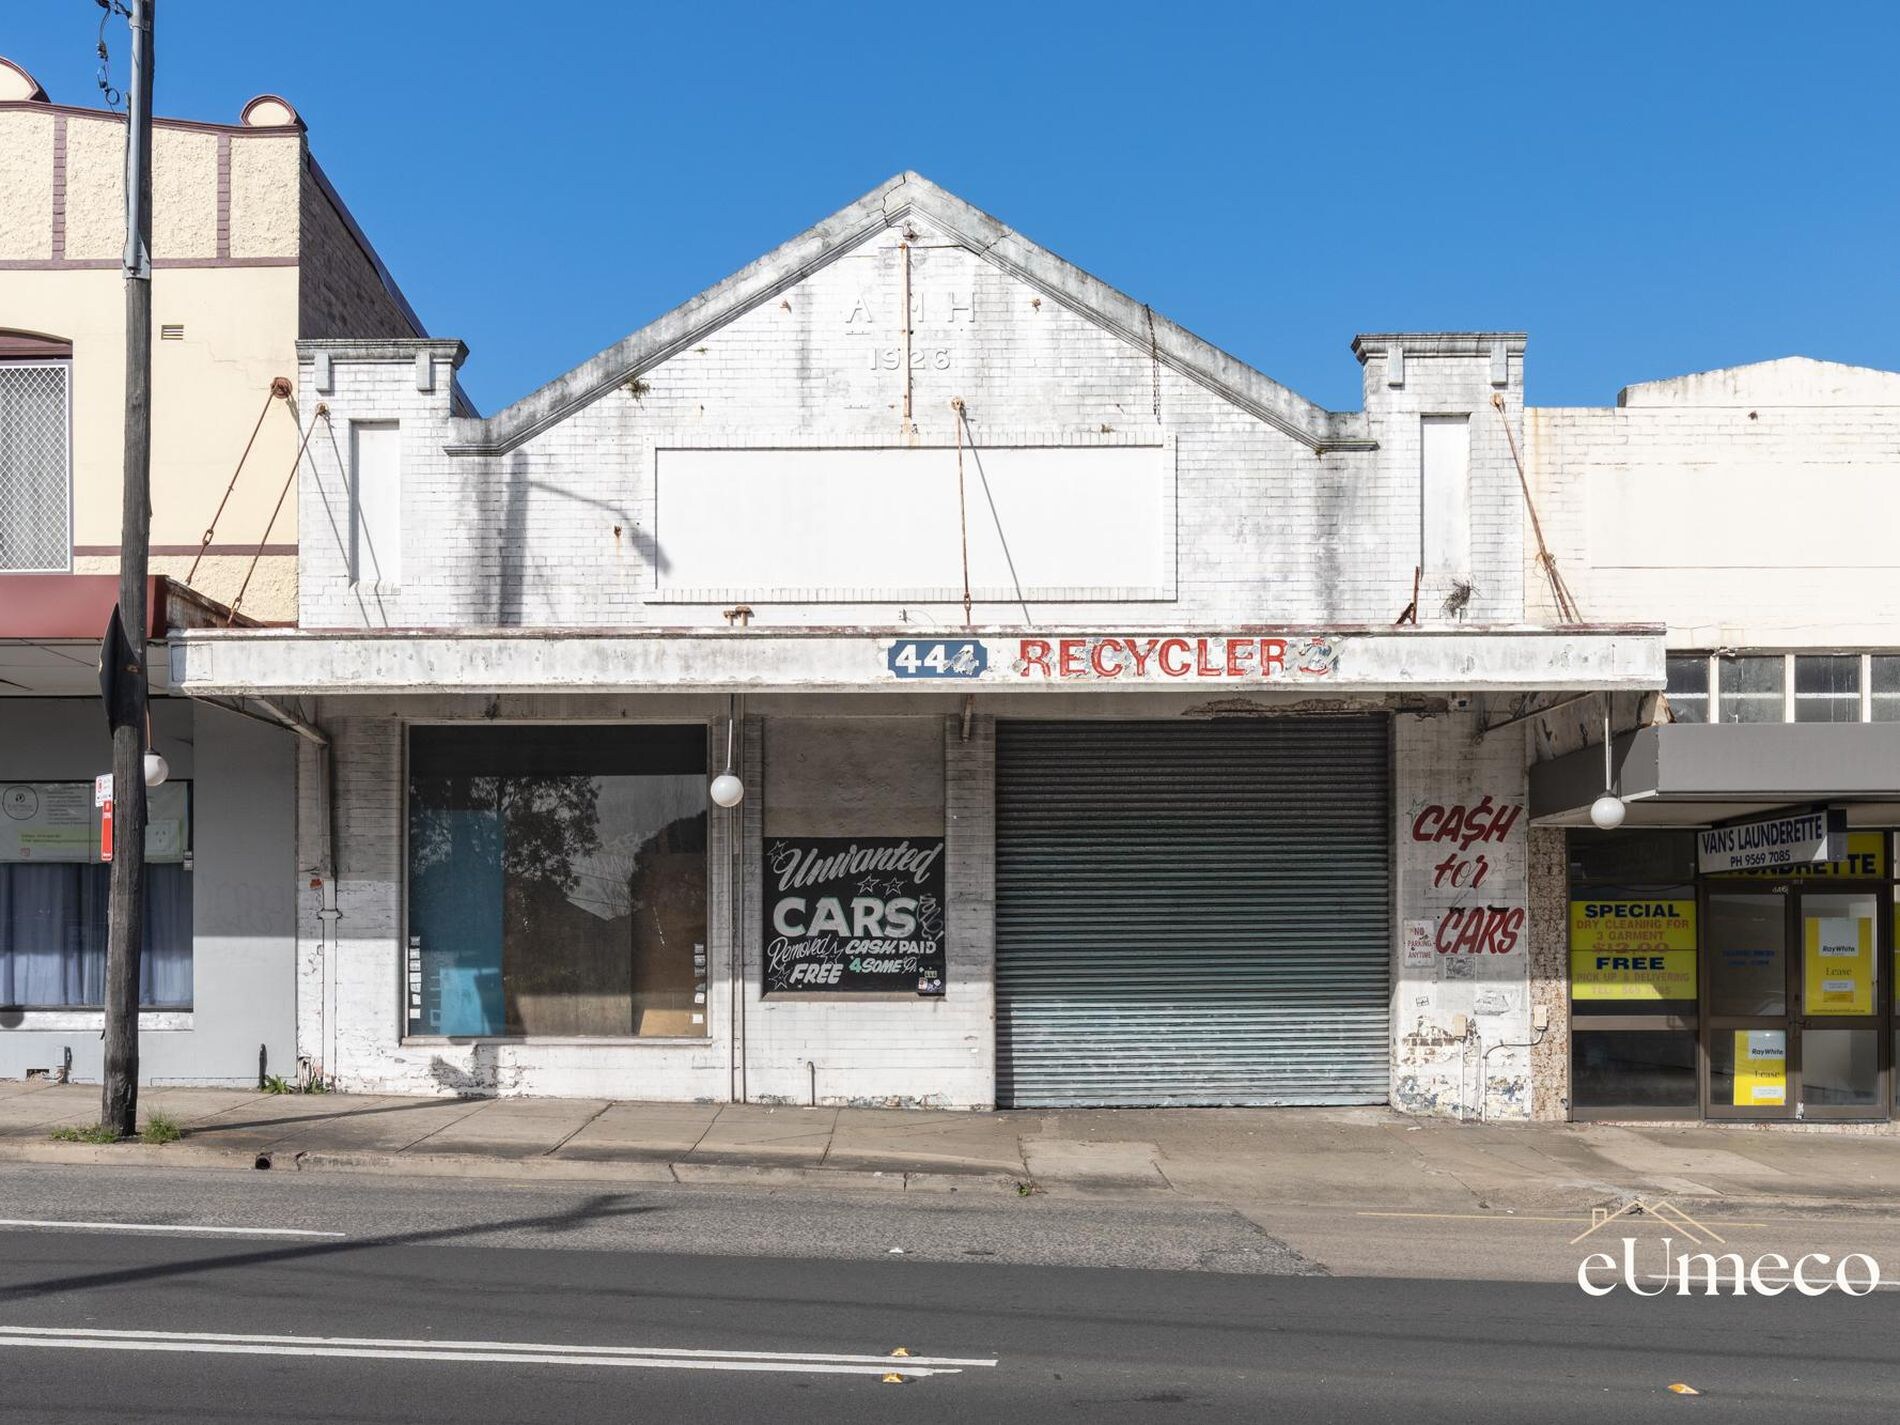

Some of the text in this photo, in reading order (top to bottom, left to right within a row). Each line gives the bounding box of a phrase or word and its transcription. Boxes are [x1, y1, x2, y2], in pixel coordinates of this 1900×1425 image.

[844, 292, 873, 324] A
[947, 291, 976, 323] H
[870, 347, 951, 371] 1926
[1702, 815, 1823, 855] VAN'S LAUNDERETTE
[1730, 850, 1791, 867] PH 9569 7085
[773, 840, 944, 892] Unwanted
[773, 896, 919, 939] CARS
[1584, 904, 1680, 918] SPECIAL
[1413, 927, 1425, 936] NO
[1435, 906, 1525, 954] CARS
[1576, 920, 1690, 929] DRY CLEANING FOR
[1608, 931, 1665, 940] GARMENT
[899, 941, 938, 954] PAID
[1407, 940, 1432, 948] PARKING
[767, 933, 832, 973] Removed
[1408, 951, 1432, 959] ANYTIME
[1596, 957, 1665, 970] FREE
[789, 963, 844, 985] FREE
[1826, 967, 1853, 976] Lease
[1755, 1070, 1780, 1079] Lease
